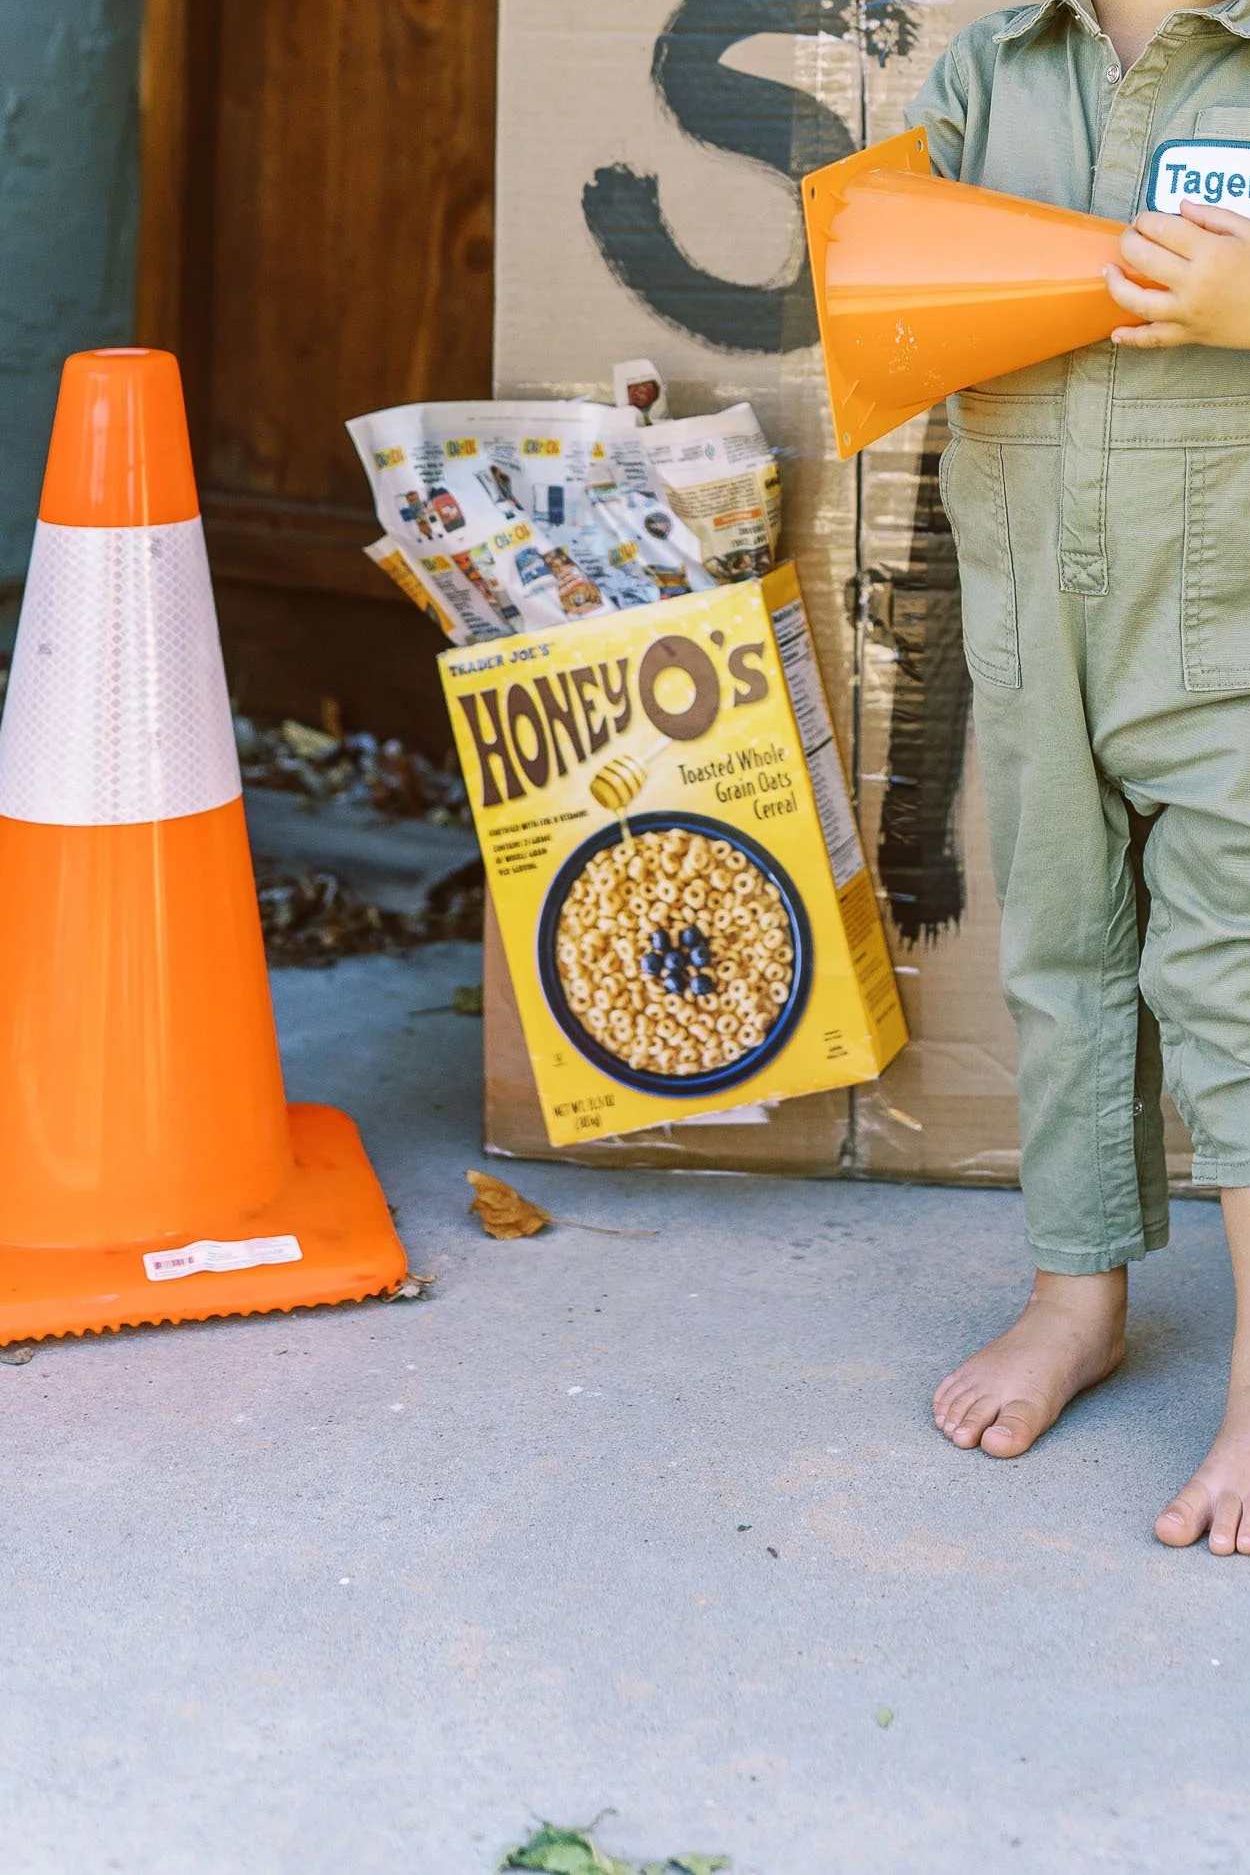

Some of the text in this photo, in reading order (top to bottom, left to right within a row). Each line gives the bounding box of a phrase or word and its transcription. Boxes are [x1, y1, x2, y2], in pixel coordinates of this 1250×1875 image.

[450, 642, 550, 678] TRADER JOE'S
[457, 657, 633, 808] HONEY
[678, 744, 785, 786] Toasted Whole
[715, 771, 792, 804] Grain Oats
[753, 793, 798, 821] Cereal
